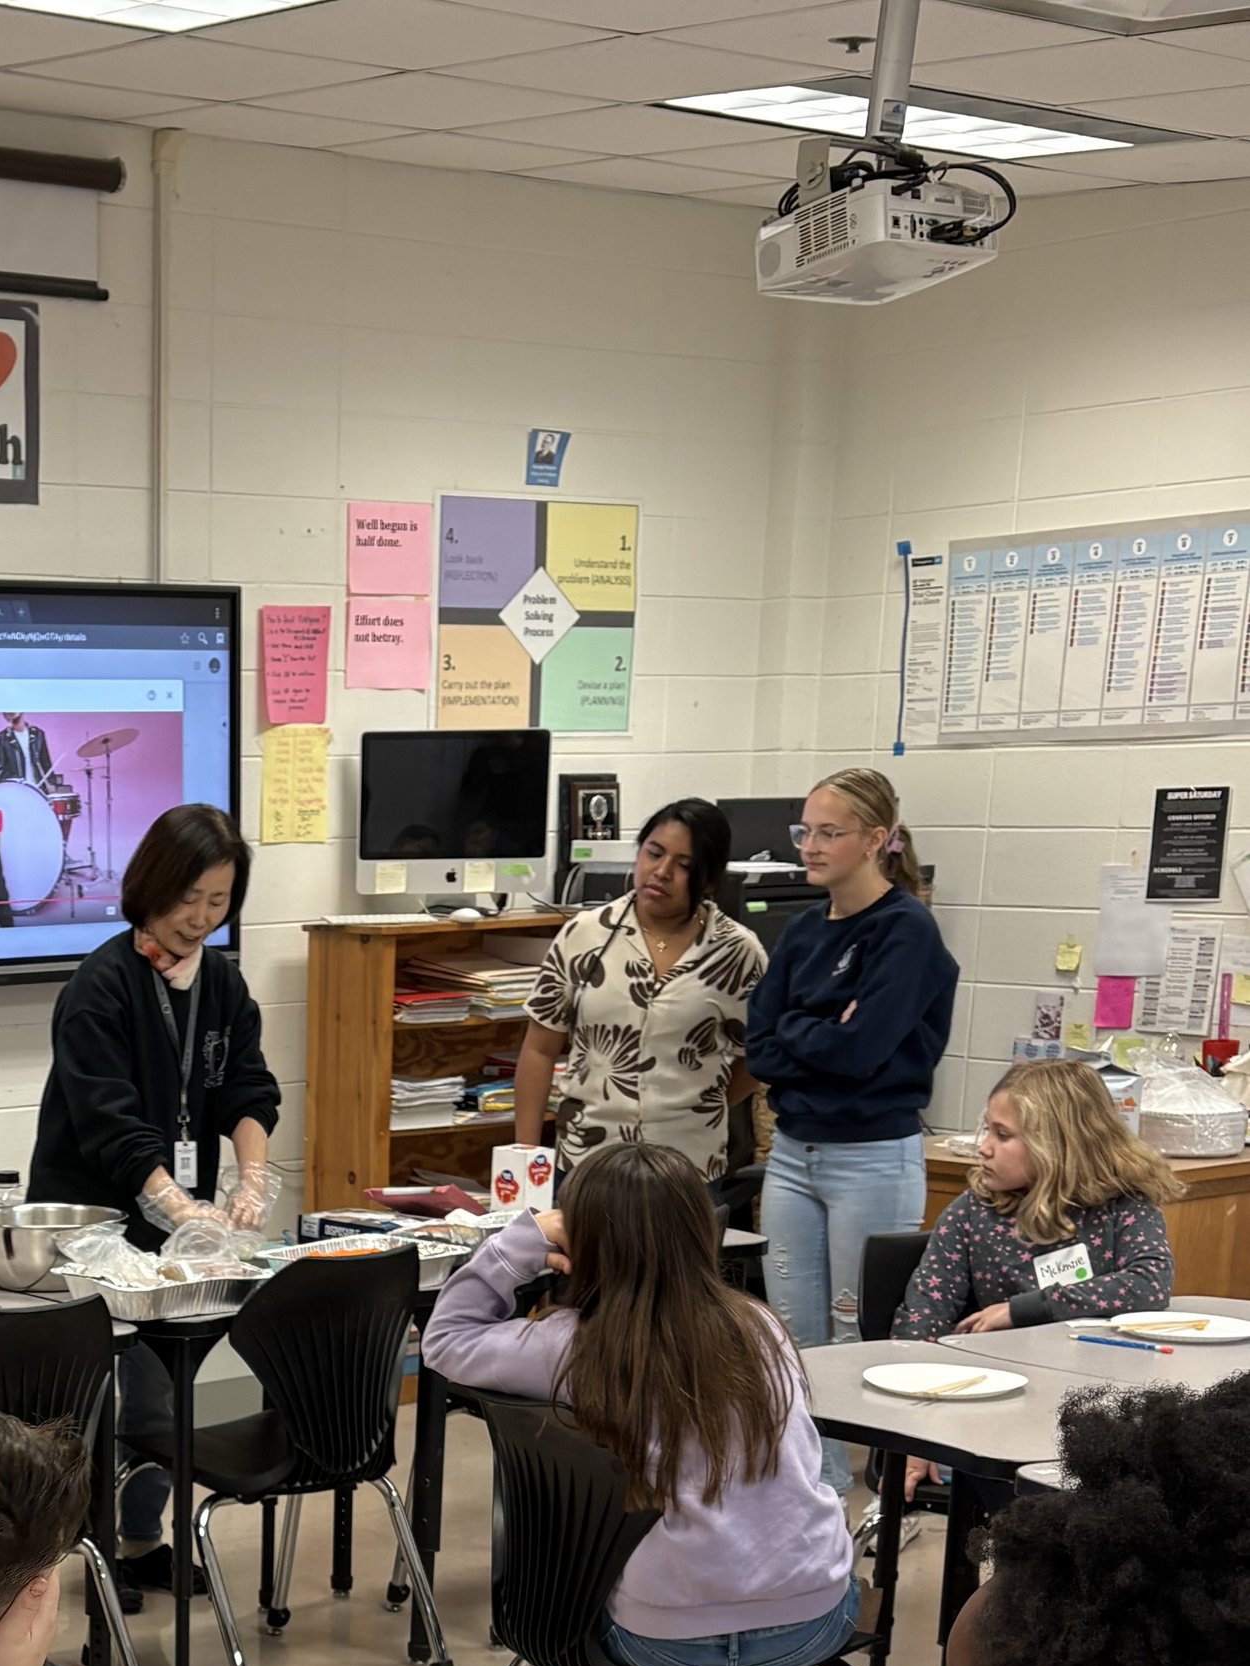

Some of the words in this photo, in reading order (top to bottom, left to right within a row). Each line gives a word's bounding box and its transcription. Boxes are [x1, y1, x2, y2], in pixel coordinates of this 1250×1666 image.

[356, 519, 378, 530] Well
[380, 520, 407, 533] begun
[410, 521, 417, 531] is
[356, 536, 375, 547] half
[377, 537, 402, 547] done.
[446, 528, 458, 544] 4.
[619, 536, 631, 551] 1.
[445, 554, 462, 563] Look
[465, 554, 483, 563] back
[574, 559, 617, 568] Understand
[619, 560, 631, 569] the
[558, 575, 589, 585] problem
[591, 575, 631, 586] (ANALYSIS)
[523, 595, 557, 605] Problem
[355, 615, 380, 626] Effort
[383, 616, 404, 627] does
[525, 611, 554, 622] Solving
[524, 628, 553, 637] Process
[354, 634, 369, 642] not
[371, 633, 403, 645] betray.
[443, 655, 455, 670] 3.
[615, 656, 626, 672] 2.
[442, 680, 462, 691] Carry
[465, 680, 478, 689] out
[480, 680, 492, 689] the
[494, 680, 510, 691] plan
[578, 680, 601, 689] Devise
[609, 680, 625, 691] plan
[1167, 792, 1188, 800] SUPER
[1189, 791, 1222, 799] SATURDAY
